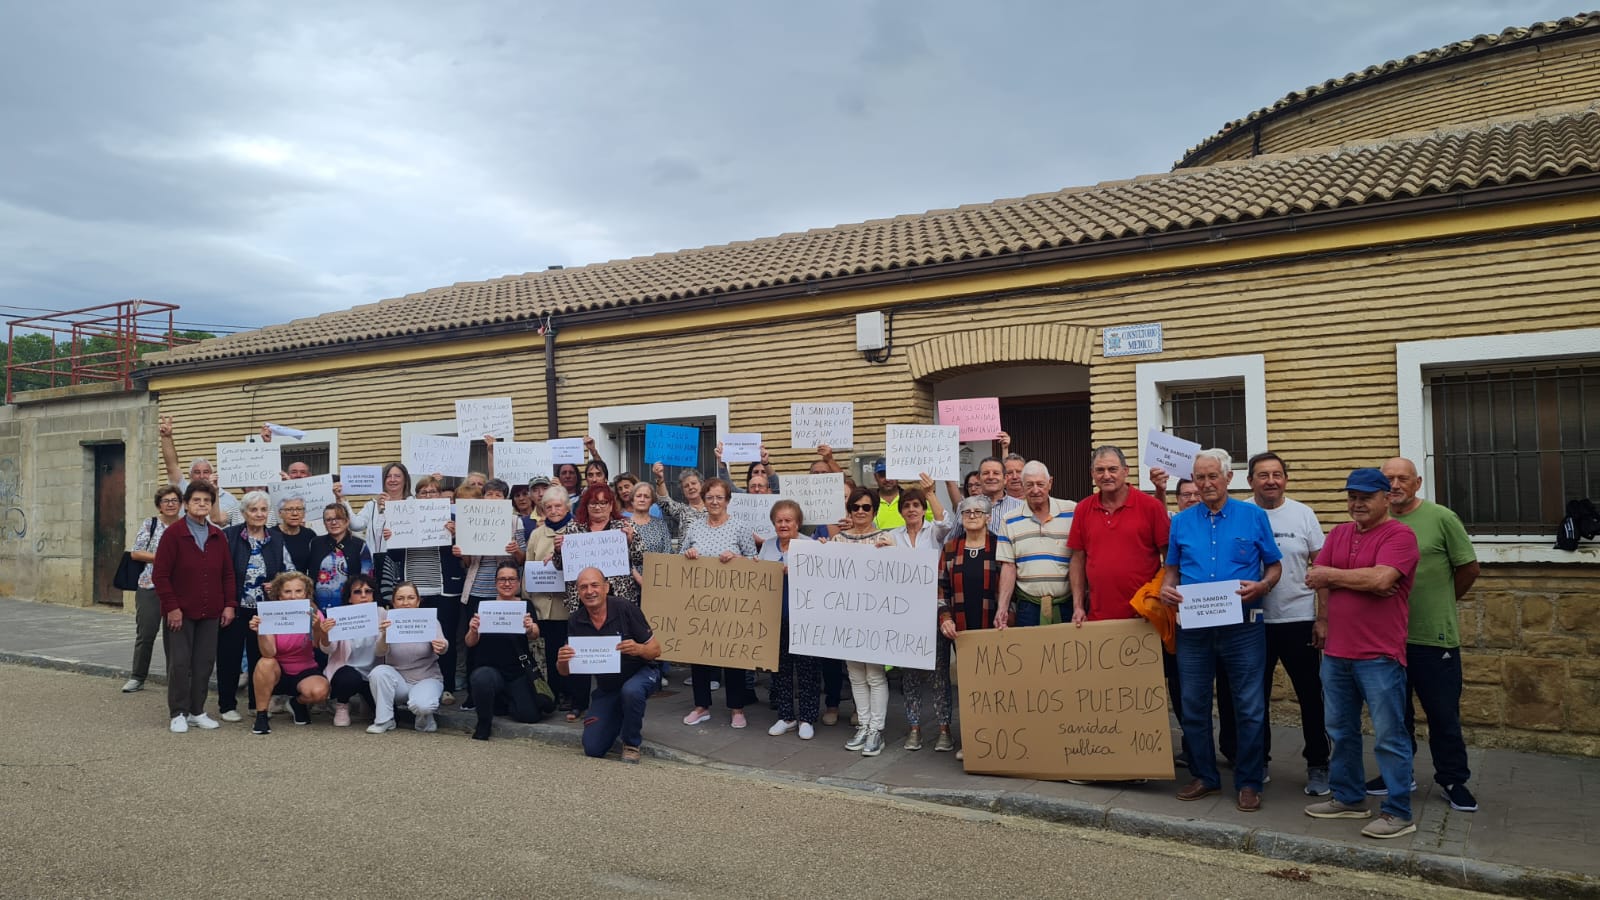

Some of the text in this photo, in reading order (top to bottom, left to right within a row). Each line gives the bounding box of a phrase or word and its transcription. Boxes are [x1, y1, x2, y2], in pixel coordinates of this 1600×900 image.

[795, 406, 805, 415] LA
[808, 406, 840, 416] SANIDAD
[820, 430, 832, 438] UN
[890, 428, 946, 440] DEFENDER
[1156, 457, 1177, 468] CALIDAD
[1170, 448, 1192, 460] SANIDAD
[463, 504, 503, 515] SANIDAD
[732, 497, 769, 508] SANIDAD
[468, 516, 506, 528] PUBLICA
[653, 563, 672, 588] EL
[794, 553, 934, 585] POR UNA SANIDAD
[684, 594, 762, 616] AGONIZA
[795, 588, 910, 615] DE CALIDAD
[1202, 595, 1228, 603] SANIDAD
[650, 615, 768, 640] SIN SANIDAD
[791, 622, 934, 656] EN EL MEDIO RURAL
[663, 637, 763, 661] SE MUERE
[975, 632, 1159, 676] MAS MEDIC@S
[969, 685, 1166, 715] PARA LOS PUEBLOS
[1058, 718, 1123, 734] sanidad
[1064, 729, 1163, 766] publica 100%
